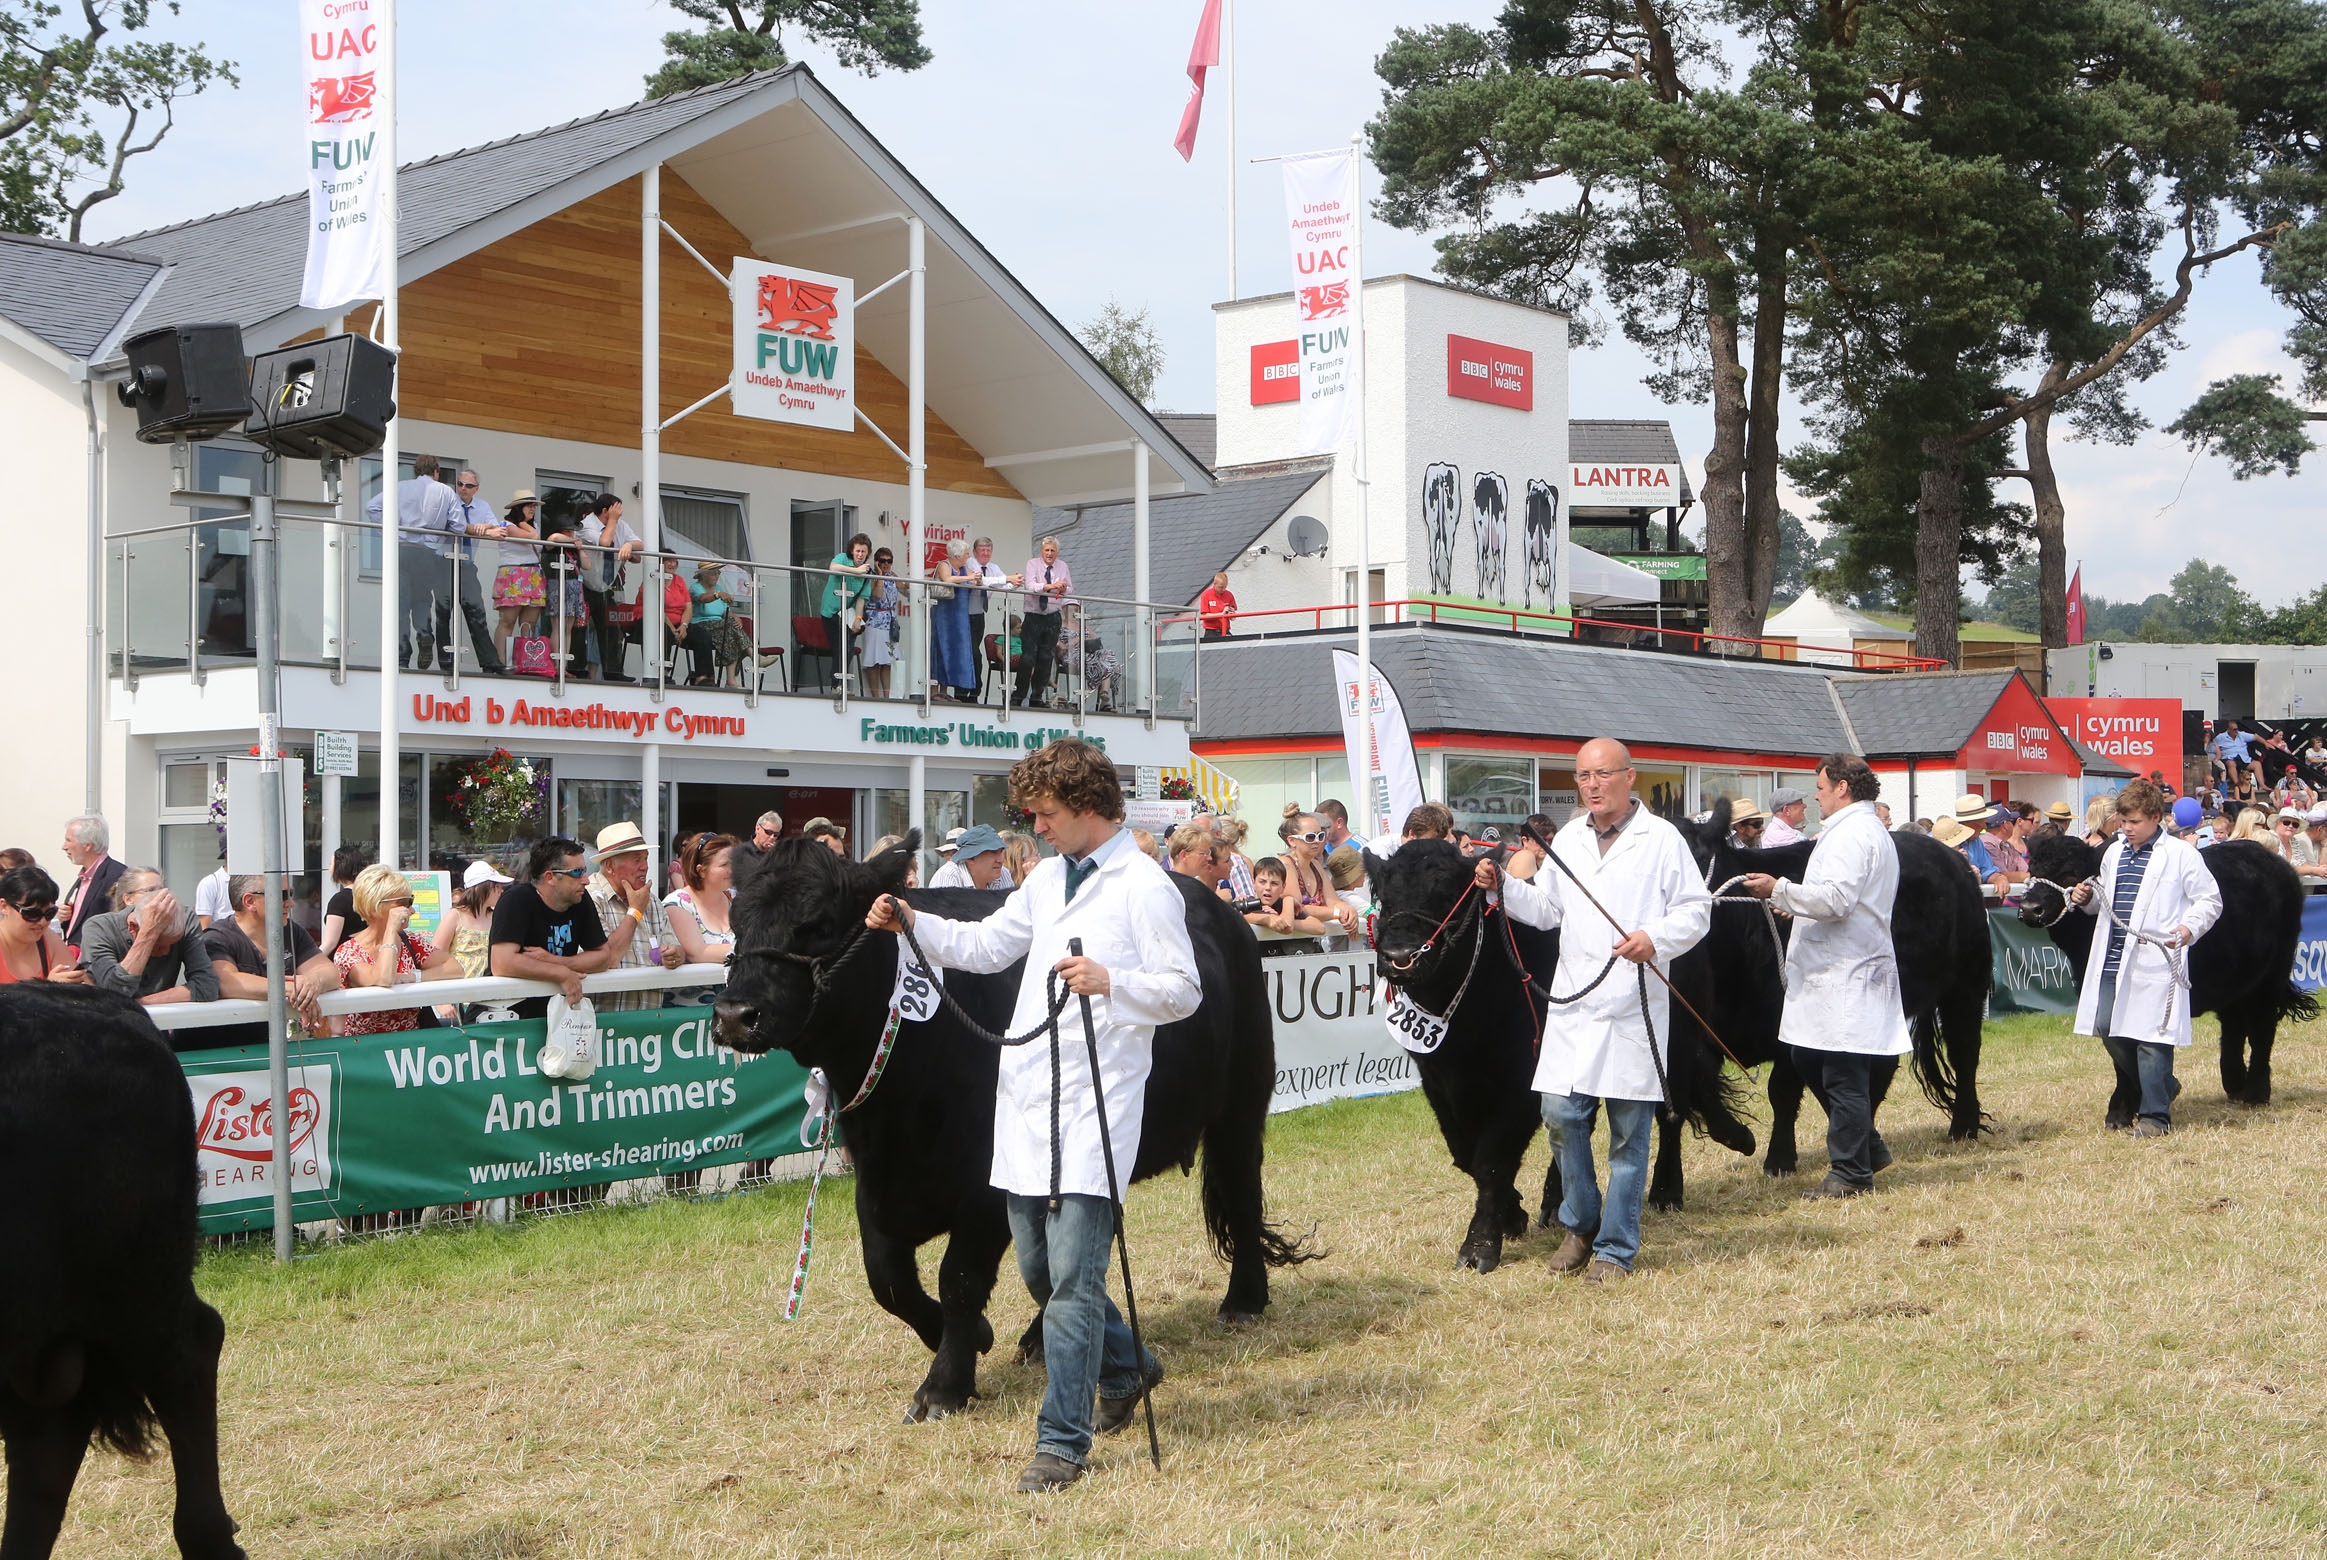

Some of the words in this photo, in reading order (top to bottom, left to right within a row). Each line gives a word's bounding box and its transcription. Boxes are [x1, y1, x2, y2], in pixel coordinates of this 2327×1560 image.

[323, 0, 369, 19] Cymru
[310, 23, 377, 61] UAC
[311, 131, 376, 171] FUW
[1303, 200, 1341, 214] Undeb
[318, 219, 334, 232] of
[1291, 212, 1351, 230] Amaethwyr
[1306, 229, 1342, 244] Cymru
[1297, 245, 1348, 274] UAC
[1301, 325, 1350, 356] FUW
[757, 332, 839, 381] FUW
[1263, 362, 1299, 380] BBC
[1461, 359, 1489, 379] BBC
[1494, 360, 1525, 377] cymru
[746, 370, 783, 388] Undeb
[785, 377, 847, 400] Amaethwyr
[1311, 388, 1321, 400] of
[1494, 376, 1522, 392] wales
[779, 393, 815, 410] Cymru
[1574, 467, 1671, 487] LANTRA
[1641, 560, 1680, 569] FARMING
[510, 699, 659, 737] Amaethwyr
[664, 706, 746, 740] Cymru
[2086, 715, 2160, 738] cymru
[327, 735, 347, 744] Builth
[959, 722, 1019, 749] Union
[1023, 727, 1046, 750] of
[1987, 731, 2015, 750] BBC
[2020, 724, 2050, 741] cymru
[2086, 736, 2154, 756] wales
[327, 743, 352, 753] Building
[327, 751, 352, 759] Services
[2020, 743, 2048, 761] wales
[1386, 1001, 1444, 1049] 2853
[384, 1037, 506, 1089] World
[1274, 1055, 1351, 1100] expert
[1355, 1051, 1412, 1088] legal
[484, 1085, 562, 1134] And
[567, 1076, 737, 1123] Trimmers
[468, 1130, 745, 1185] www.lister-shearing.com
